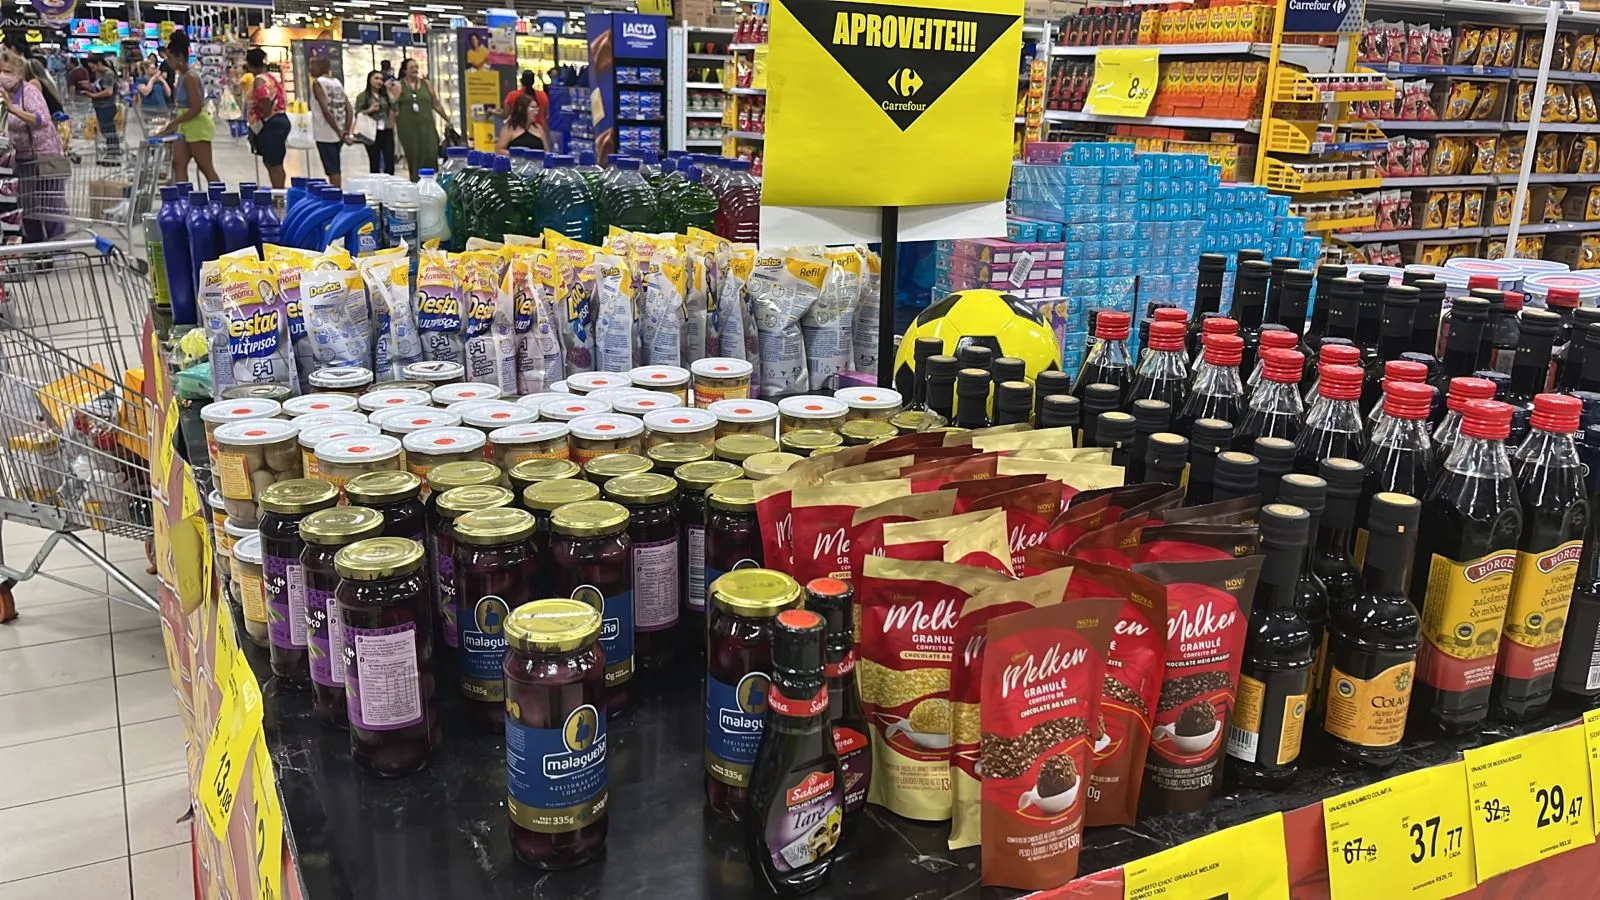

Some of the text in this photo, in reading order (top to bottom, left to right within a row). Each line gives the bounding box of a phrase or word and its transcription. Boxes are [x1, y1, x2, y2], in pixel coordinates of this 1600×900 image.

[1289, 0, 1331, 11] Carrefour
[623, 22, 657, 40] LACTA
[832, 11, 978, 53] APROVEITE!!!
[881, 100, 927, 112] Carrefour
[755, 257, 782, 267] Destac
[800, 268, 821, 277] Refil
[309, 281, 341, 298] Destac
[882, 599, 959, 633] Melk
[1180, 637, 1222, 652] GRANULÉ
[904, 652, 941, 660] CHOCOLATE
[1002, 642, 1088, 699] Melken
[1024, 677, 1068, 699] GRANULÉ
[1020, 703, 1051, 718] CHOCOLATE
[1060, 697, 1077, 707] LEITE
[1028, 693, 1057, 706] CONFEITO
[547, 741, 606, 772] malagueña
[724, 768, 743, 782] 335g
[549, 779, 588, 791] AZEITONAS
[791, 779, 831, 801] Sakura
[1535, 784, 1583, 829] 29,47
[552, 815, 574, 826] 335g
[1409, 815, 1464, 864] 37,77
[1129, 882, 1158, 896] CONFEITO
[1199, 862, 1220, 874] MELKEN
